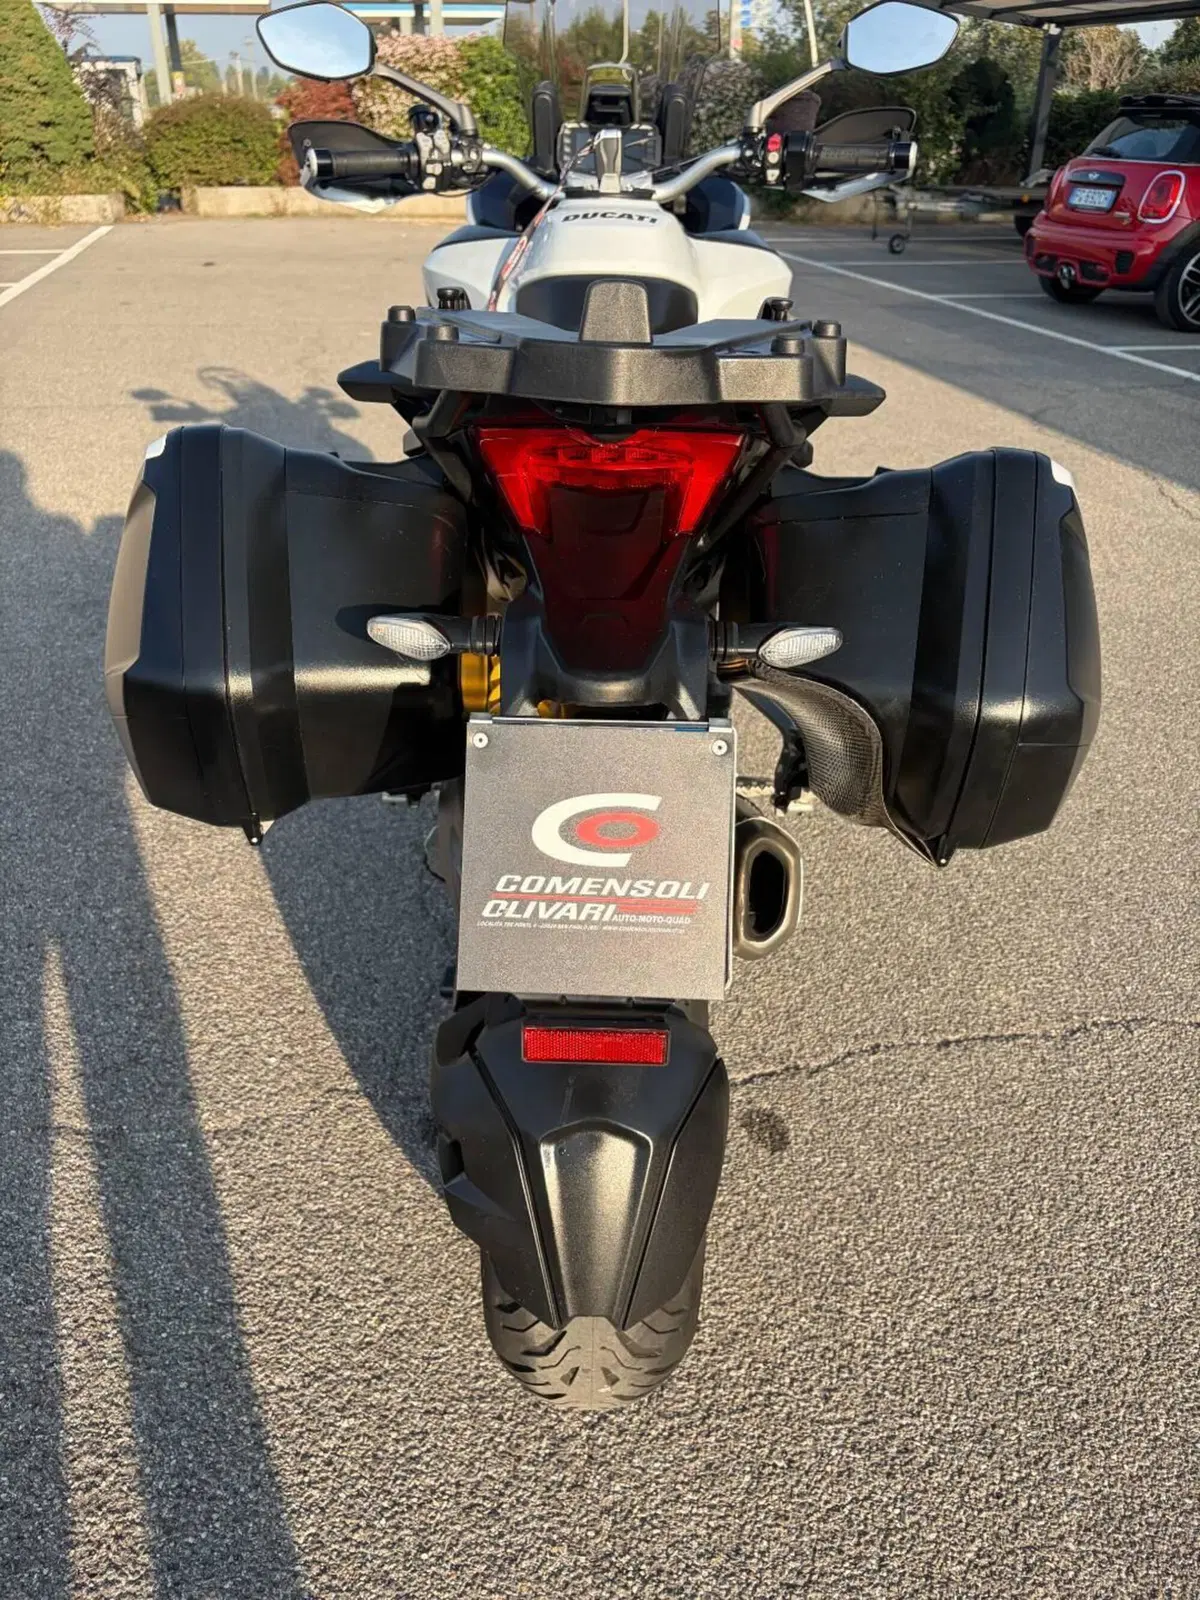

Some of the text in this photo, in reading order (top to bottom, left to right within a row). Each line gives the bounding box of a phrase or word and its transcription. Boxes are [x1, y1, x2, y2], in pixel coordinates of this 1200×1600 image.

[561, 211, 658, 224] DUCATI
[495, 874, 710, 900] COMENSOLI
[481, 899, 618, 921] OLIVARI
[612, 914, 692, 925] AUTO-MOTO-QUAD
